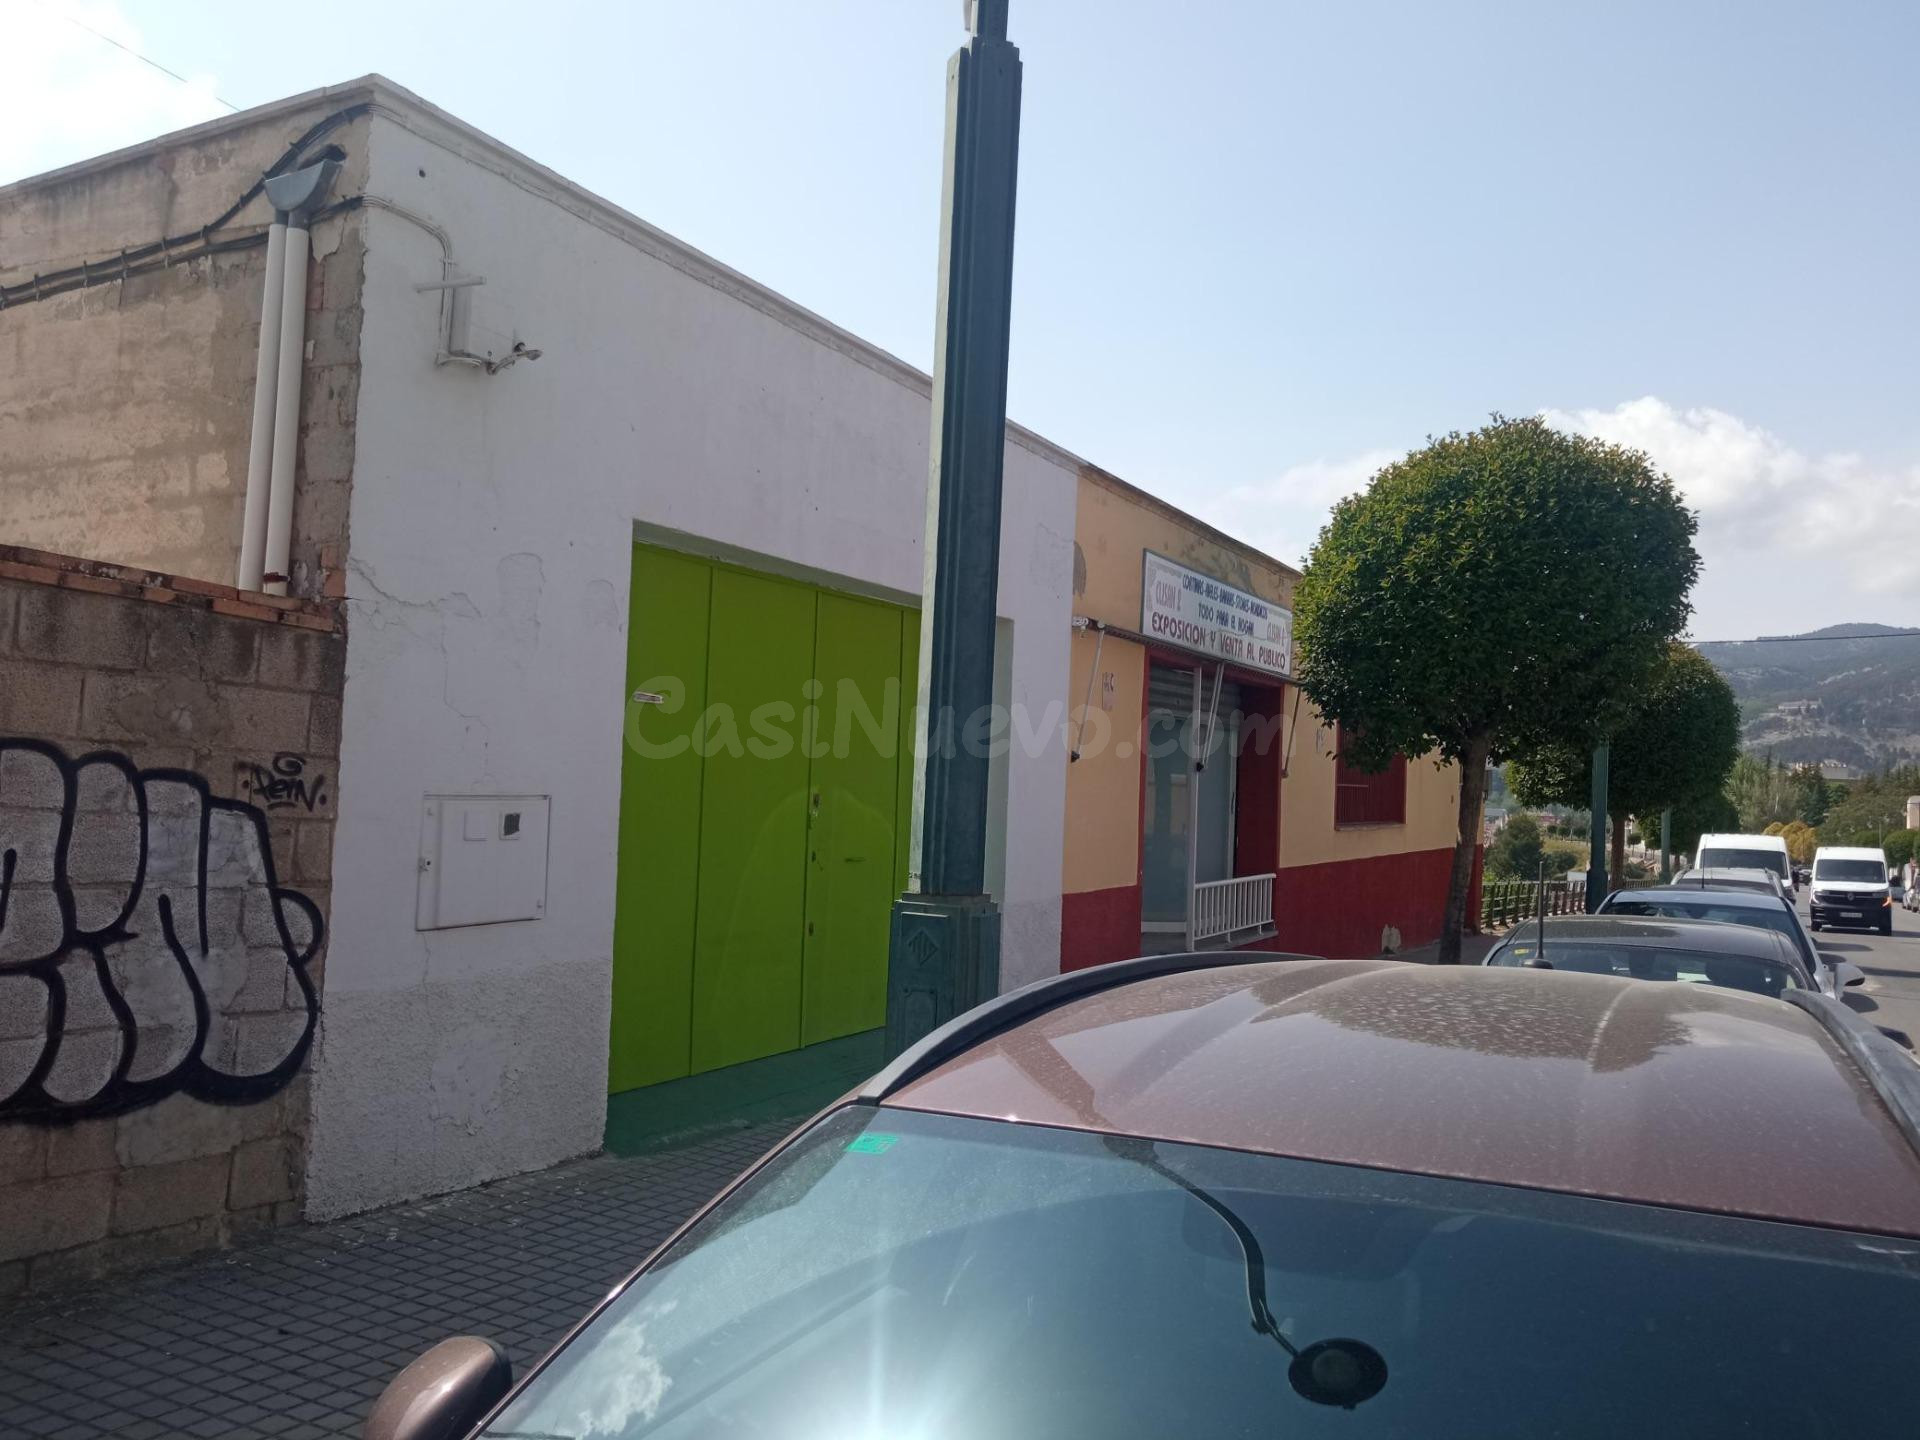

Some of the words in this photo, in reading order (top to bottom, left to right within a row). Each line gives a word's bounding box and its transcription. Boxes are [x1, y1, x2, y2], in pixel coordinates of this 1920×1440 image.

[1198, 602, 1214, 622] TODO
[1216, 609, 1229, 628] PARA
[1152, 611, 1205, 649] EXPOSICION
[1210, 630, 1216, 650] Y
[1220, 633, 1243, 659] VENTA
[1247, 641, 1255, 661] AL
[1259, 645, 1286, 670] PUBLICO
